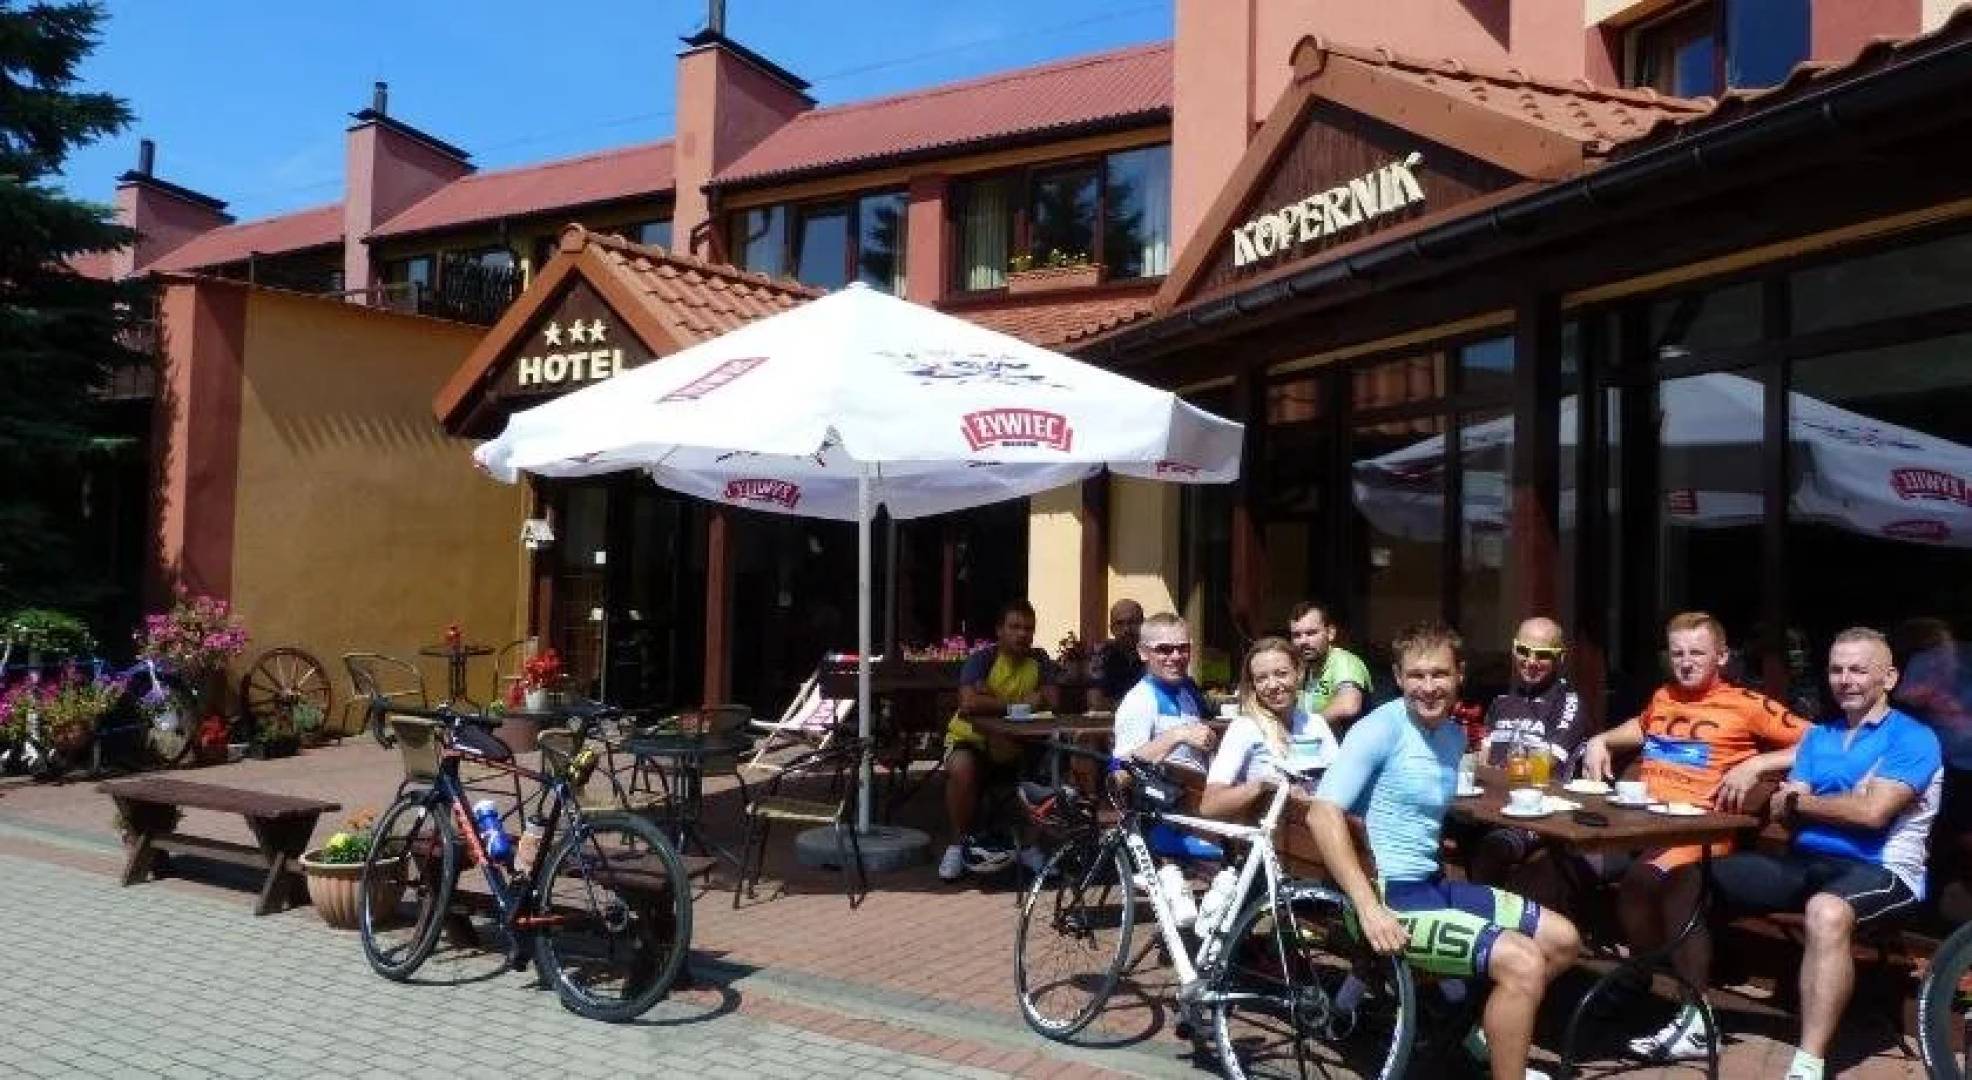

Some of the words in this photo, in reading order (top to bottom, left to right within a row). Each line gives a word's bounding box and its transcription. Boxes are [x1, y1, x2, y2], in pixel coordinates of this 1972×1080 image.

[1232, 151, 1425, 266] KOPERNIK
[518, 349, 623, 386] HOTEL
[972, 411, 1062, 440] ŻYWIEC
